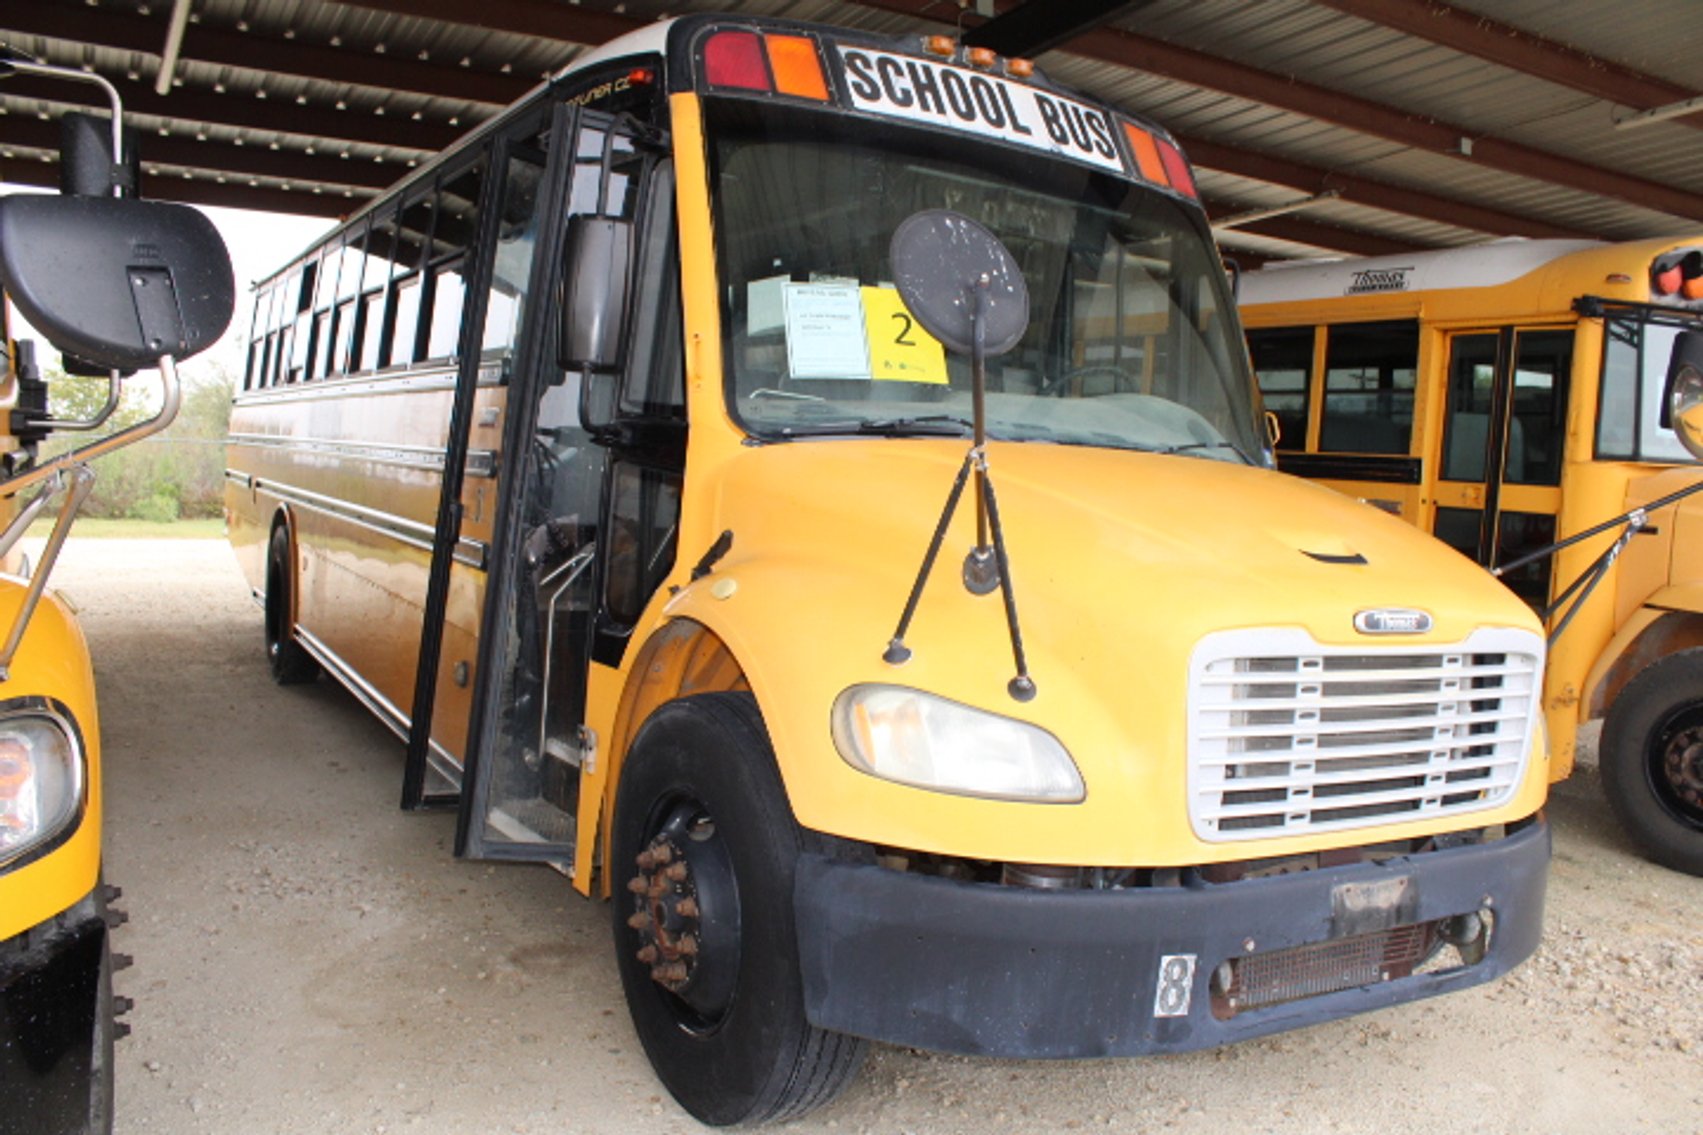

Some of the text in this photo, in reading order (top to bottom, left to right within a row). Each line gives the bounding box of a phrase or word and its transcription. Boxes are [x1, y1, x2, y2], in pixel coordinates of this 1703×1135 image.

[845, 51, 1118, 160] SCHOOL BUS
[892, 312, 916, 346] 2
[1159, 957, 1189, 1014] 8
